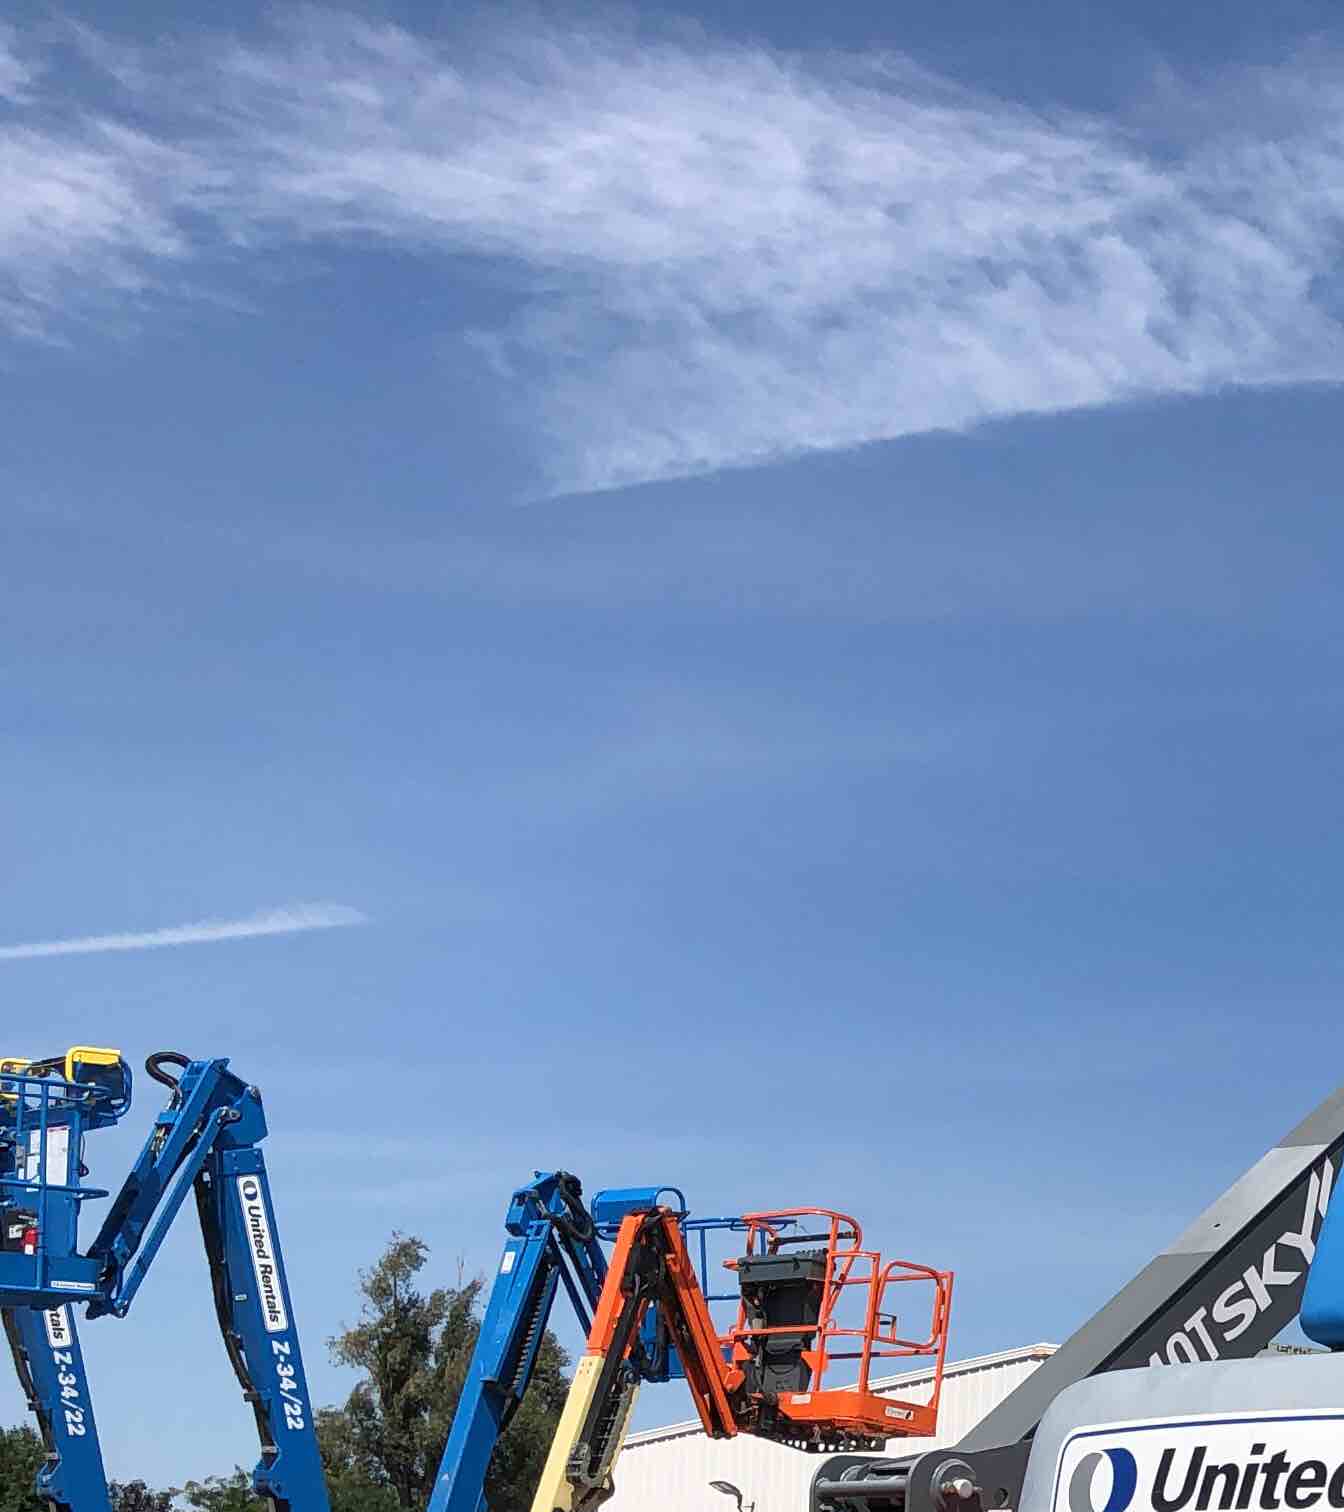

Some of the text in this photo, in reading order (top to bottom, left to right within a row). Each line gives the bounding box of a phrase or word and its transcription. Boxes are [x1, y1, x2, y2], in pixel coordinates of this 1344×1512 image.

[248, 1205, 279, 1323] United Rentals
[53, 1350, 87, 1437] Z-34/22
[272, 1339, 305, 1431] Z-34/22
